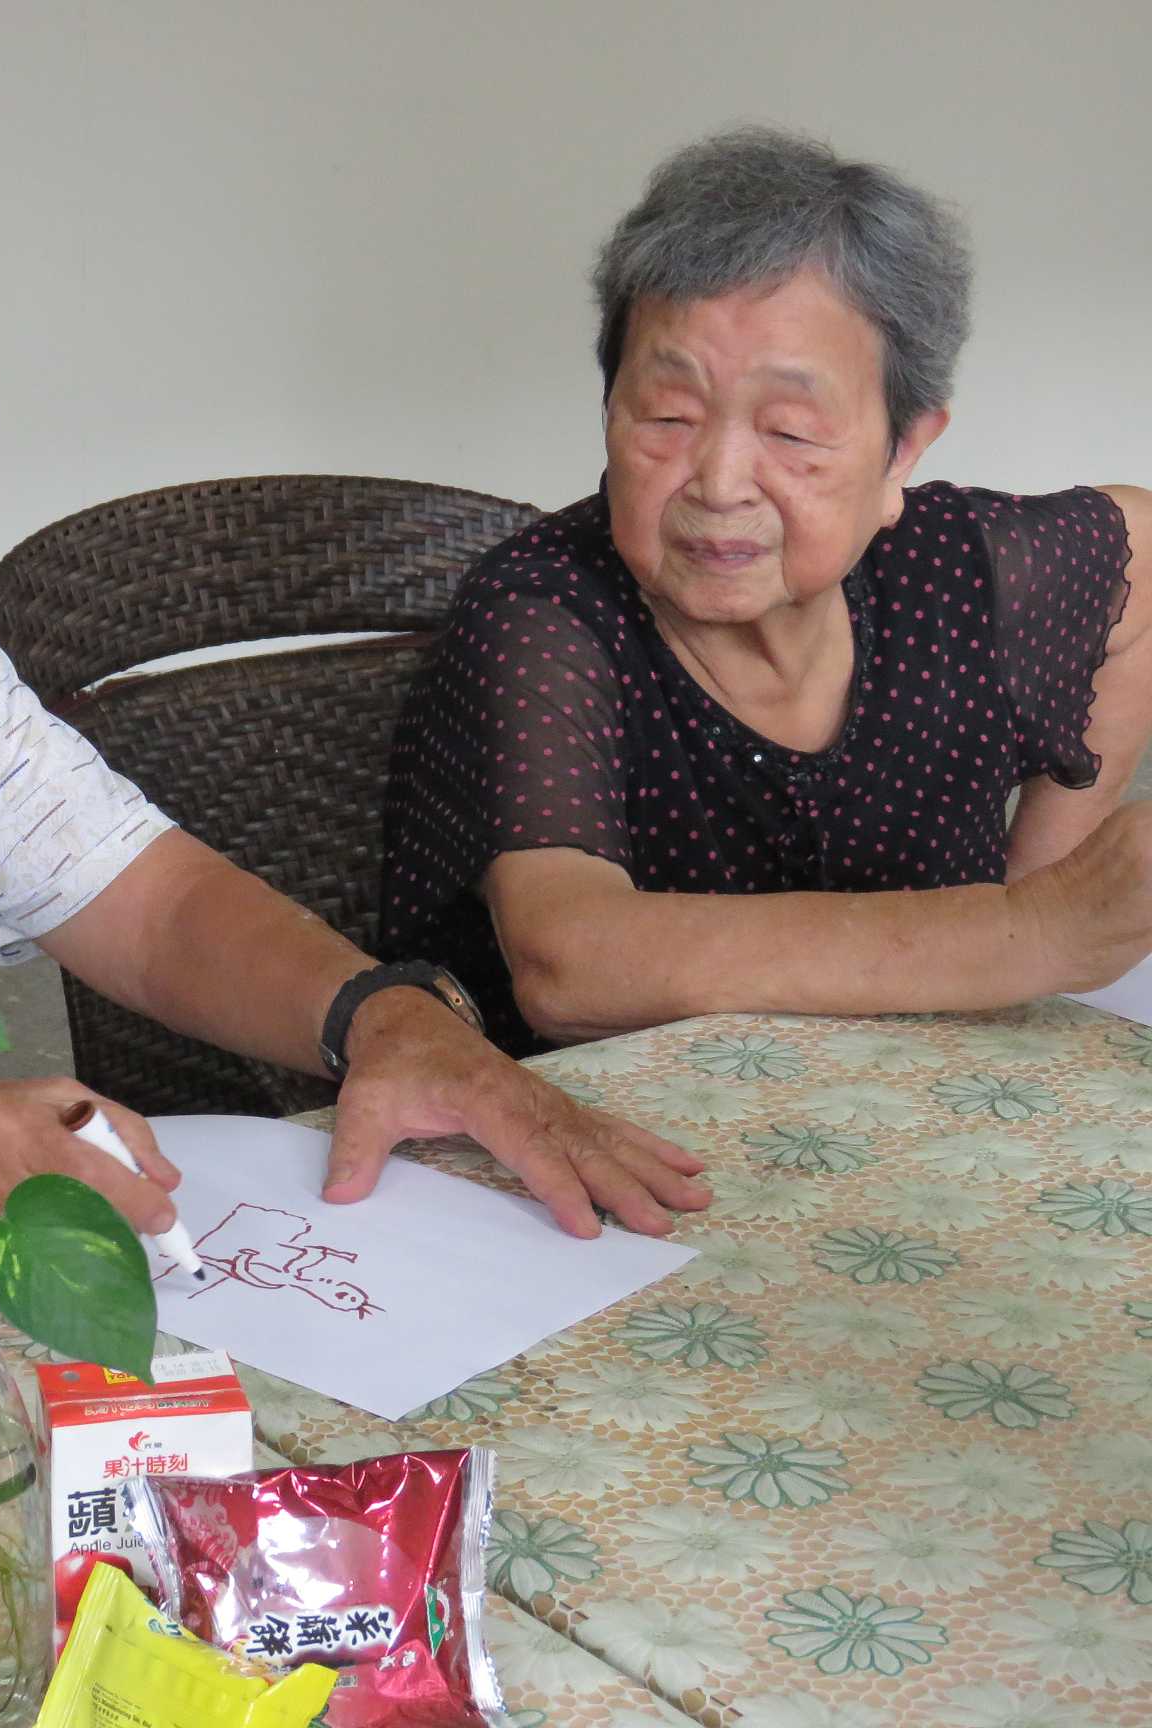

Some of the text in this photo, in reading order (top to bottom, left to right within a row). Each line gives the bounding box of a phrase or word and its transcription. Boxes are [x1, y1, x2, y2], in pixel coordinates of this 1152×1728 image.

[102, 1452, 189, 1479] 果汁時刻
[70, 1541, 112, 1554] Apple
